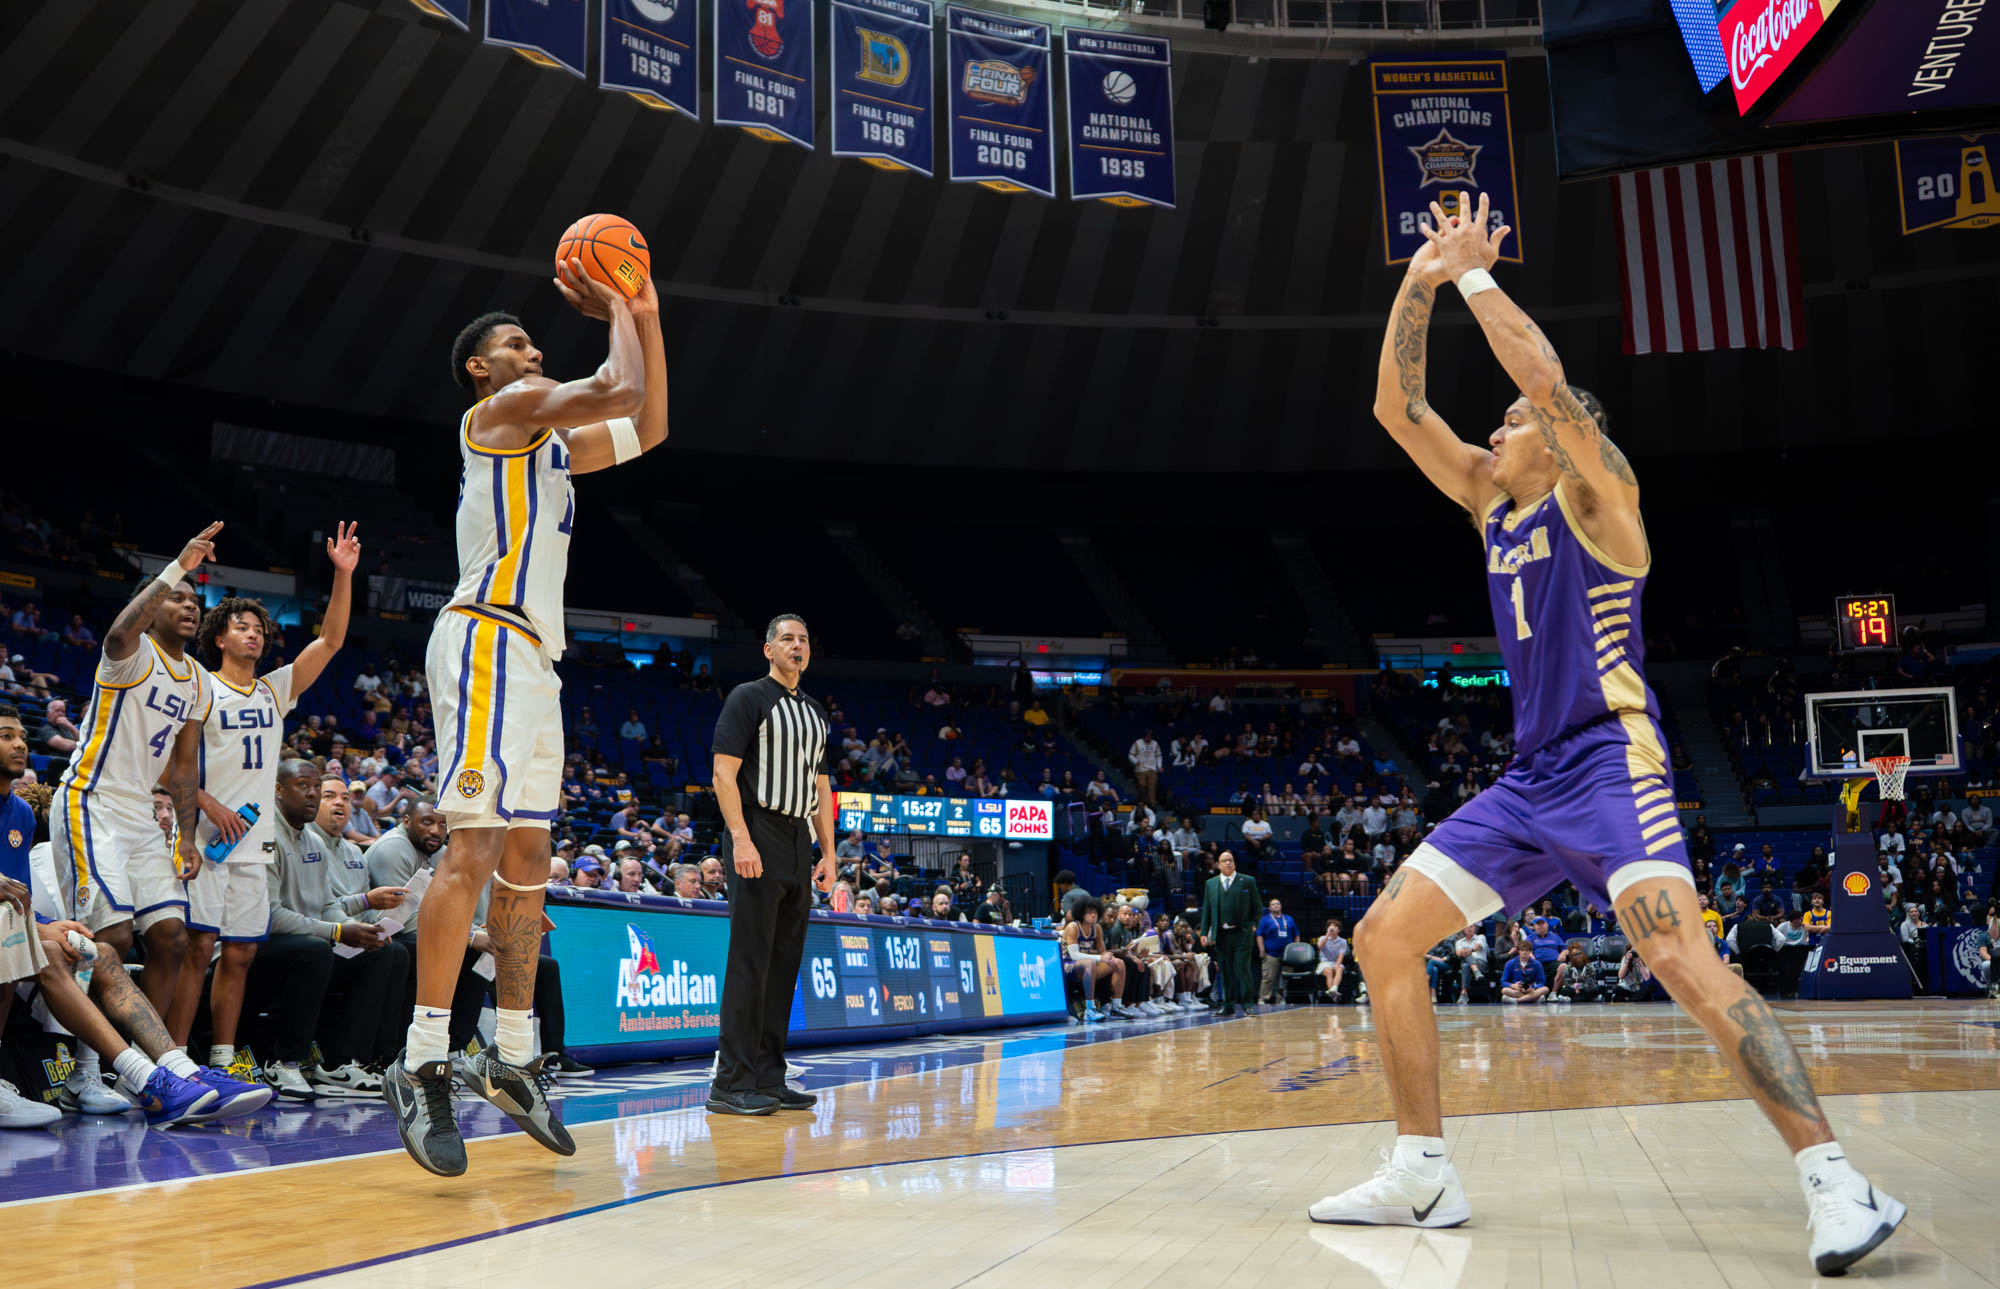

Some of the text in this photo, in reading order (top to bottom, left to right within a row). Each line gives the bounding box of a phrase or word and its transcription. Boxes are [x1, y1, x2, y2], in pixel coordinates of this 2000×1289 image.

[621, 33, 681, 66] FINAL FOUR
[1079, 37, 1156, 54] MEN'S BASKETBALL
[630, 53, 672, 85] 1953
[982, 68, 1020, 83] FINAL
[1382, 71, 1496, 83] WOMEN'S BASKETBALL
[735, 70, 796, 99] FINAL FOUR
[967, 74, 1020, 95] FOUR
[746, 89, 785, 118] 1981
[1411, 97, 1471, 110] NATIONAL
[852, 103, 915, 128] FINAL FOUR
[1089, 112, 1153, 130] NATIONAL
[1393, 109, 1492, 128] CHAMPIONS
[862, 120, 905, 147] 1986
[970, 128, 1033, 149] FINAL FOUR
[1082, 125, 1161, 145] CHAMPIONS
[977, 144, 1027, 169] 2006
[1425, 161, 1470, 169] CHAMPIONS
[1100, 157, 1146, 178] 1935
[1917, 173, 1954, 201] 20
[408, 591, 453, 609] WBR
[1511, 576, 1533, 641] 1
[1847, 600, 1889, 618] 15:27
[1860, 617, 1887, 645] 19
[145, 686, 194, 723] LSU
[219, 707, 274, 730] LSU
[149, 724, 173, 758] 4
[241, 735, 263, 770] 11
[901, 800, 942, 817] 15:27
[954, 806, 963, 819] 2
[978, 803, 1002, 813] LSU
[1009, 805, 1048, 821] PAPA
[928, 821, 936, 832] 2
[979, 817, 1002, 834] 65
[1008, 822, 1048, 834] JOHNS
[302, 852, 322, 864] LSU
[344, 860, 364, 870] LSU
[840, 935, 869, 950] TIMEOUTS
[885, 935, 921, 970] 15:27
[1839, 954, 1898, 966] Equipment
[1840, 965, 1871, 974] Share
[616, 957, 718, 1008] Acadian
[811, 957, 837, 999] 65
[960, 960, 975, 994] 57
[845, 986, 880, 1016] FOULS 2
[893, 991, 927, 1014] PERIOD 2
[935, 985, 943, 1012] 4
[619, 1009, 720, 1032] Ambulance Service
